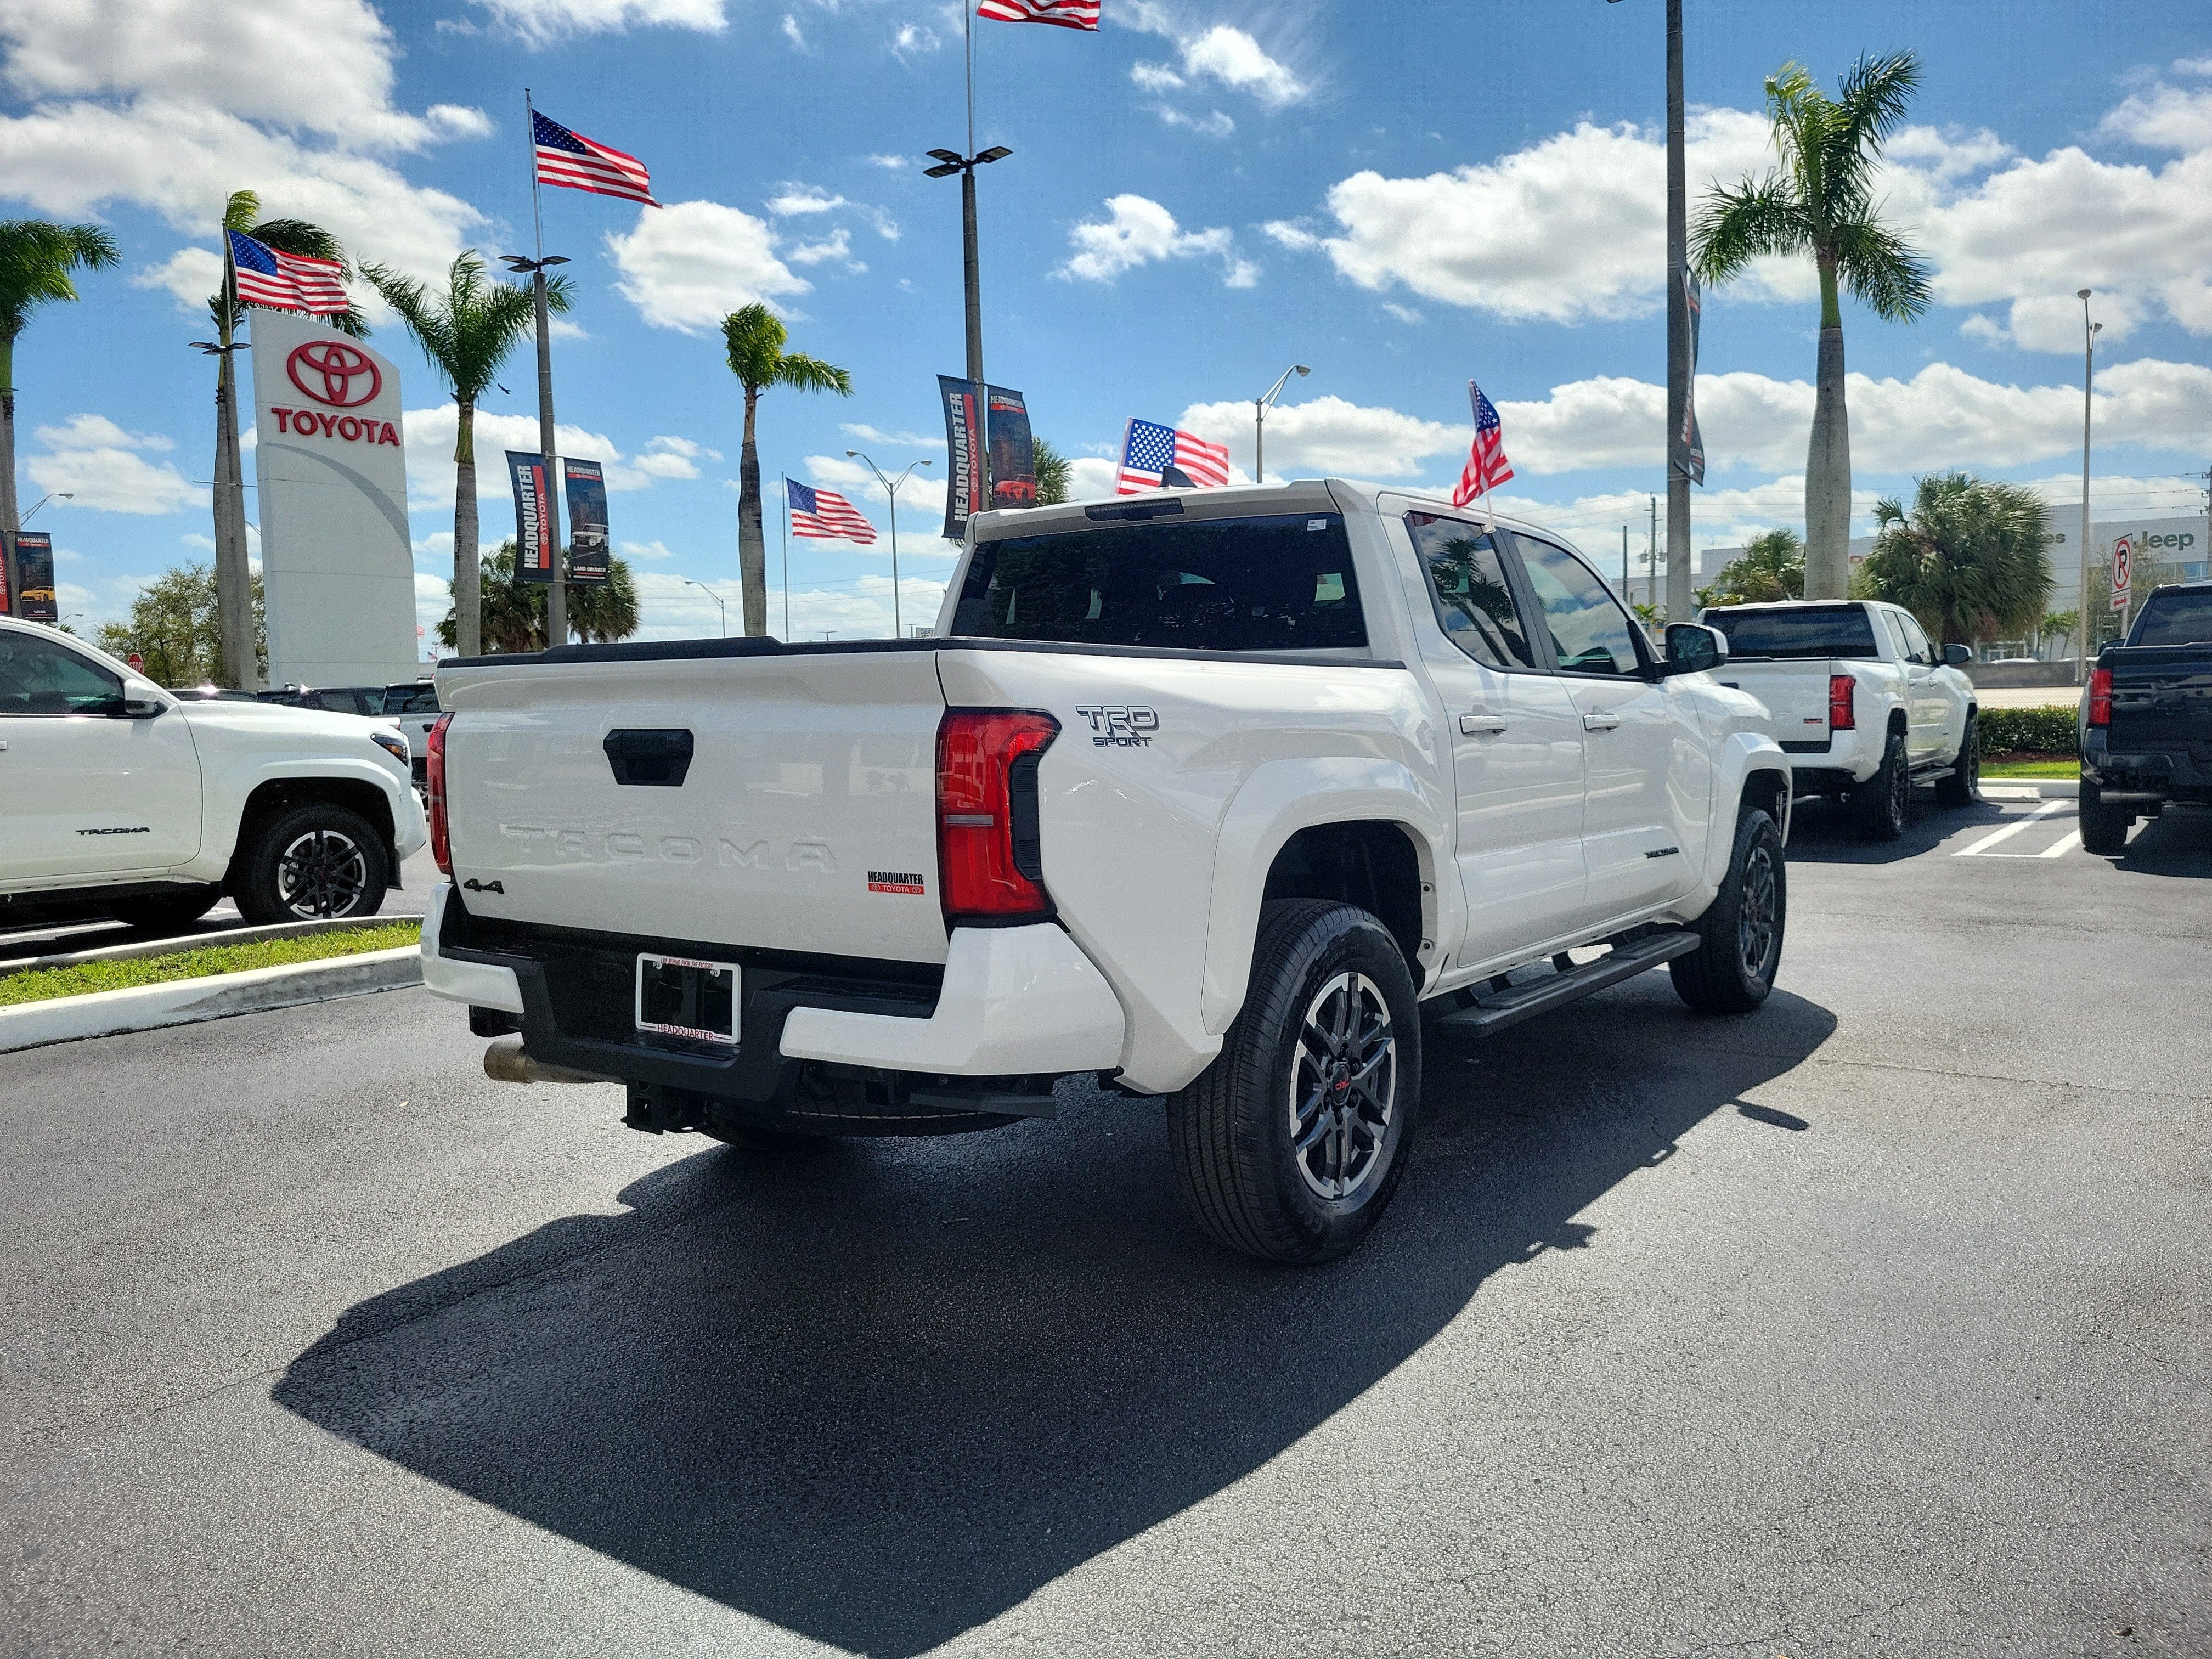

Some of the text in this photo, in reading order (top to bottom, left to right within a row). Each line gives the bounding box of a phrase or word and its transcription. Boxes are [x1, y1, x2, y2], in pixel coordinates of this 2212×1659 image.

[271, 408, 400, 447] TOYOTA
[949, 393, 970, 521] HEADQUARTER
[969, 428, 977, 476] TOYOTA
[517, 465, 539, 568] HEADQUARTER
[2134, 531, 2194, 550] Jeep
[129, 662, 143, 672] STOP
[1075, 705, 1160, 738] TRD
[1092, 737, 1153, 747] SPORT
[75, 827, 150, 836] TACOMA
[501, 826, 837, 873] TACOMA
[868, 871, 923, 884] HEADQUARTER
[882, 885, 910, 893] TOYOTA
[658, 1024, 713, 1040] HEADQUARTER
